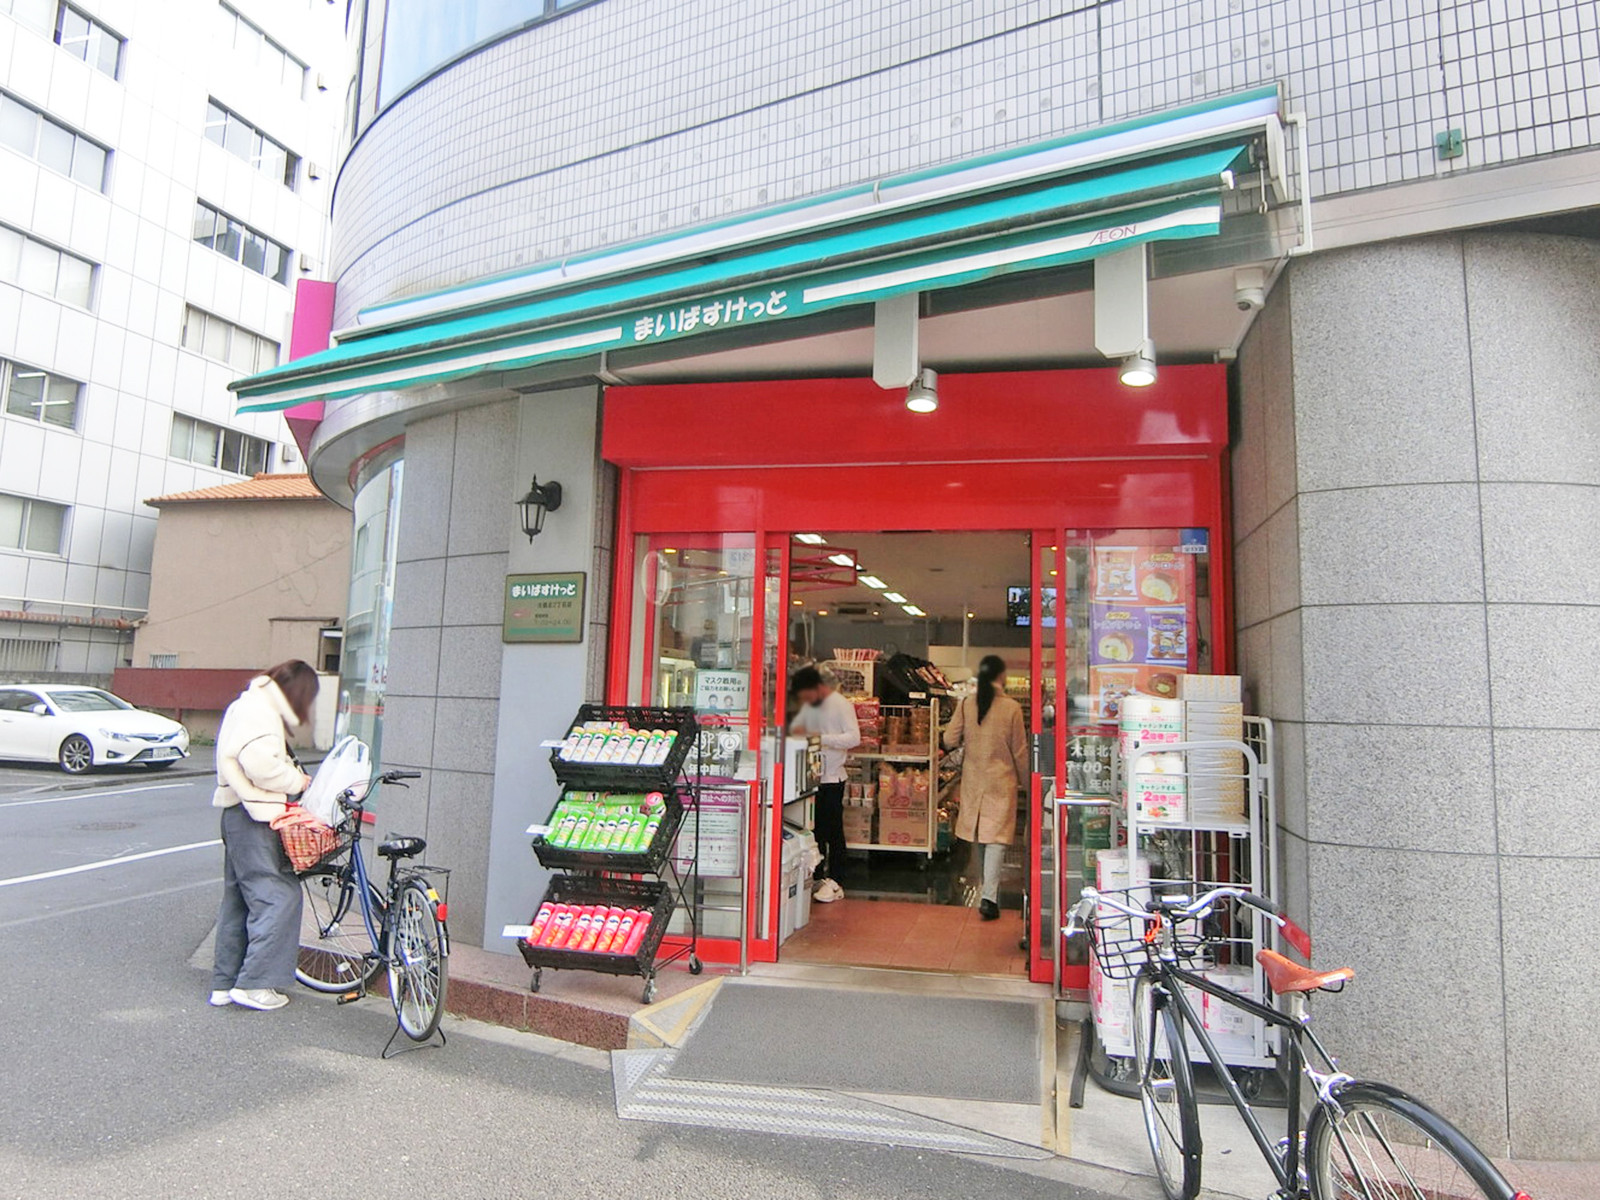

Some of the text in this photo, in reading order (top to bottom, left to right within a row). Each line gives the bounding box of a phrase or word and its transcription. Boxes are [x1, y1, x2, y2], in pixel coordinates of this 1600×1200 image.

[633, 290, 788, 342] まいばすけっと
[512, 584, 576, 597] まいばすけっと
